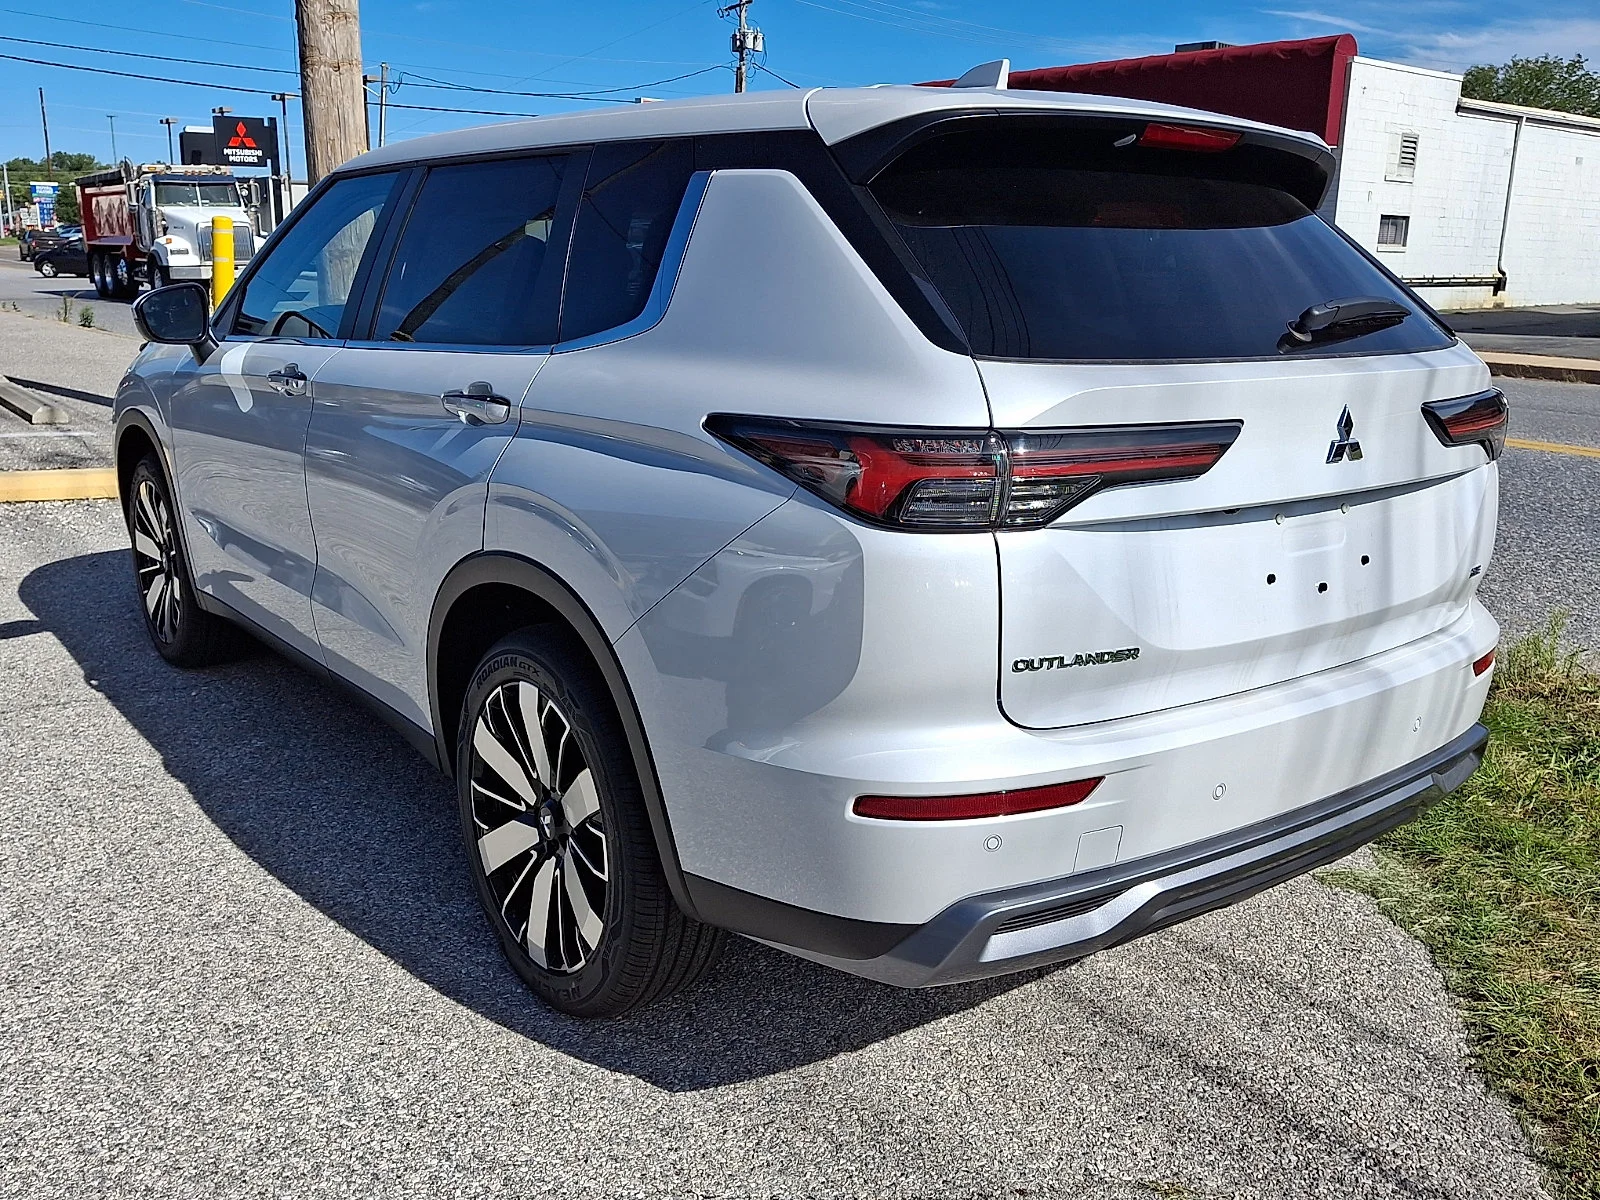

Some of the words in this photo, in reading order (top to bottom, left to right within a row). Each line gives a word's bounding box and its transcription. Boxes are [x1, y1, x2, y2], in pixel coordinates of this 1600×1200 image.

[223, 148, 263, 157] MITSUBISHI
[229, 155, 259, 163] MOTORS
[1011, 647, 1140, 673] OUTLANDER
[476, 656, 518, 690] ROADIAN
[518, 661, 540, 677] GTX
